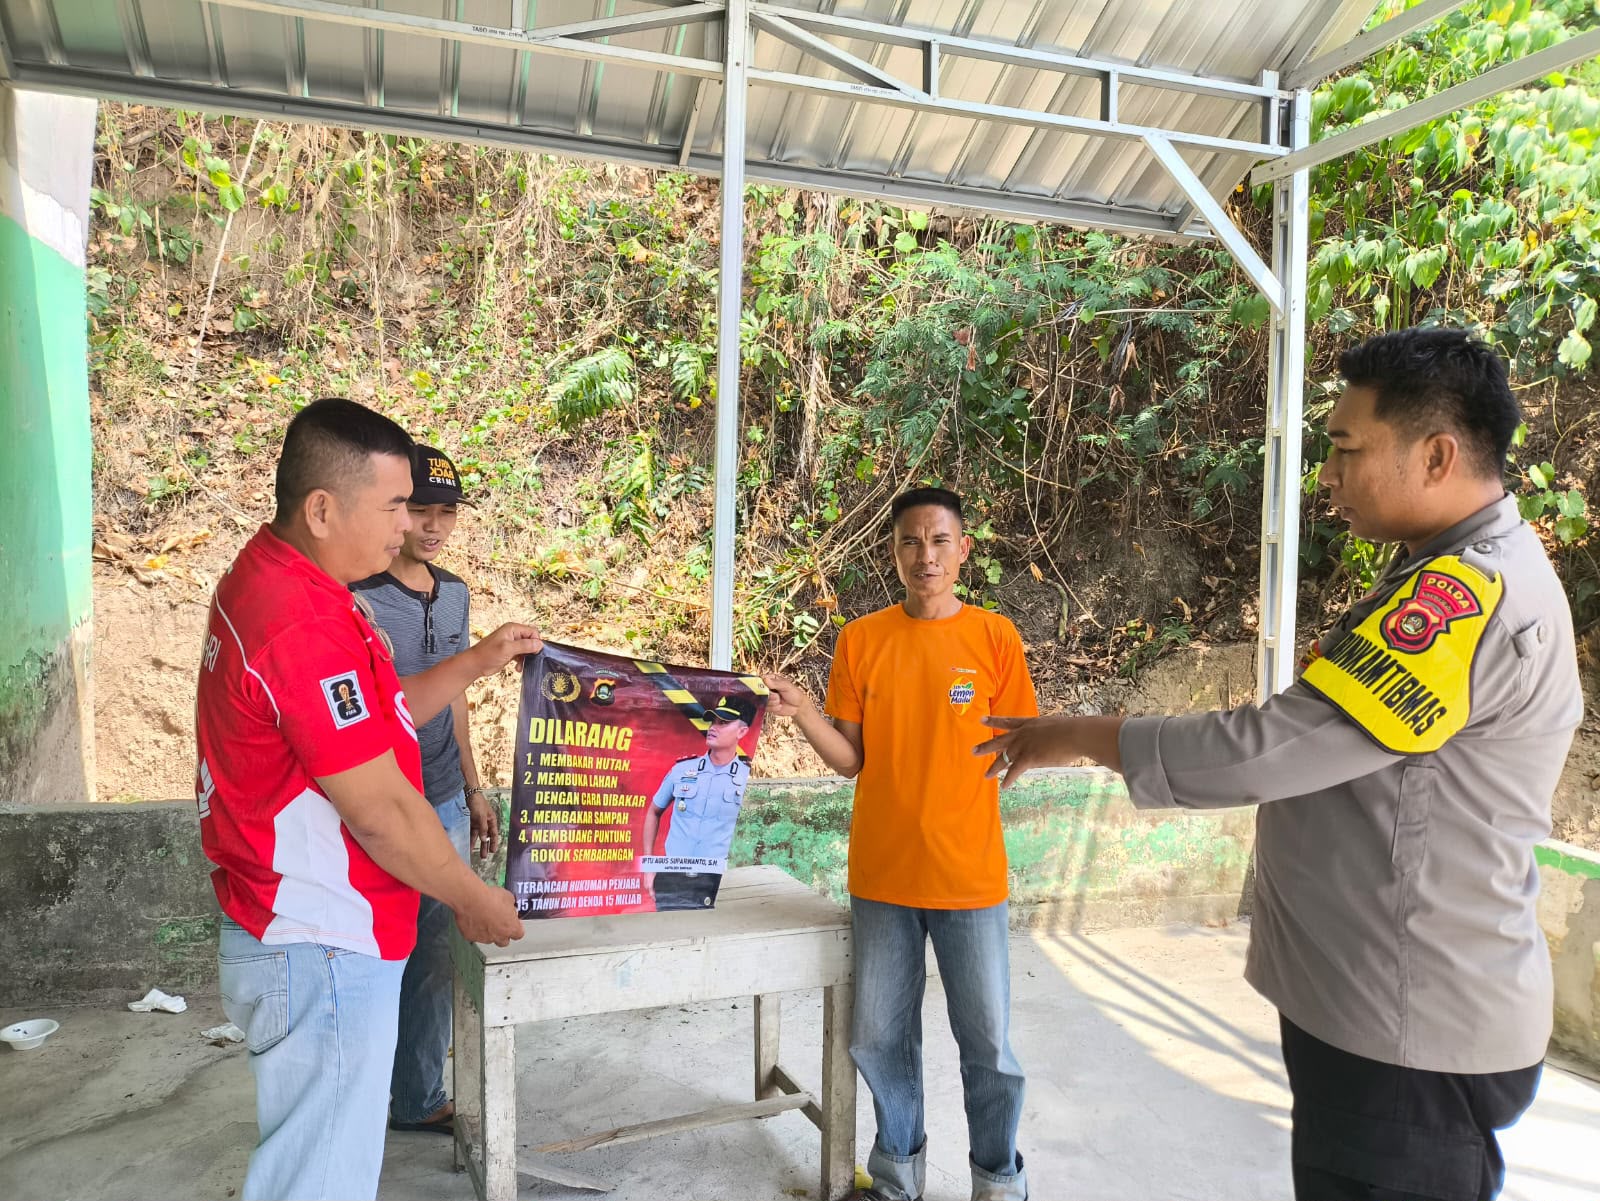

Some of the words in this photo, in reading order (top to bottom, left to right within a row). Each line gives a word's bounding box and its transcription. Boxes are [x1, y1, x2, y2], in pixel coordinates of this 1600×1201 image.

[429, 476, 456, 487] CRIME
[1427, 577, 1470, 609] POLDA
[529, 717, 633, 751] DILARANG
[526, 752, 534, 766] 1.
[540, 753, 594, 769] MEMBAKAR
[523, 771, 534, 785] 2.
[537, 772, 588, 787] MEMBUKA
[589, 775, 618, 788] LAHAN
[535, 791, 579, 805] DENGAN
[581, 792, 601, 806] CARA
[602, 793, 646, 808] DIBAKAR
[520, 809, 530, 823] 3.
[533, 810, 593, 824] MEMBAKAR
[594, 811, 629, 825] SAMPAH
[518, 829, 528, 843] 4.
[531, 829, 592, 843] MEMBUANG
[594, 830, 631, 843] PUNTUNG
[531, 849, 571, 862] ROKOK
[573, 848, 634, 862] SEMBARANGAN
[517, 880, 568, 894] TERANCAM
[569, 879, 607, 892] HUKUMAN
[608, 878, 640, 890] PENJARA
[517, 898, 529, 912] 15
[531, 898, 560, 910] TAHUN
[560, 897, 577, 909] DAN
[578, 895, 603, 908] DENDA
[605, 895, 614, 906] 15
[615, 893, 642, 905] MILIAR
